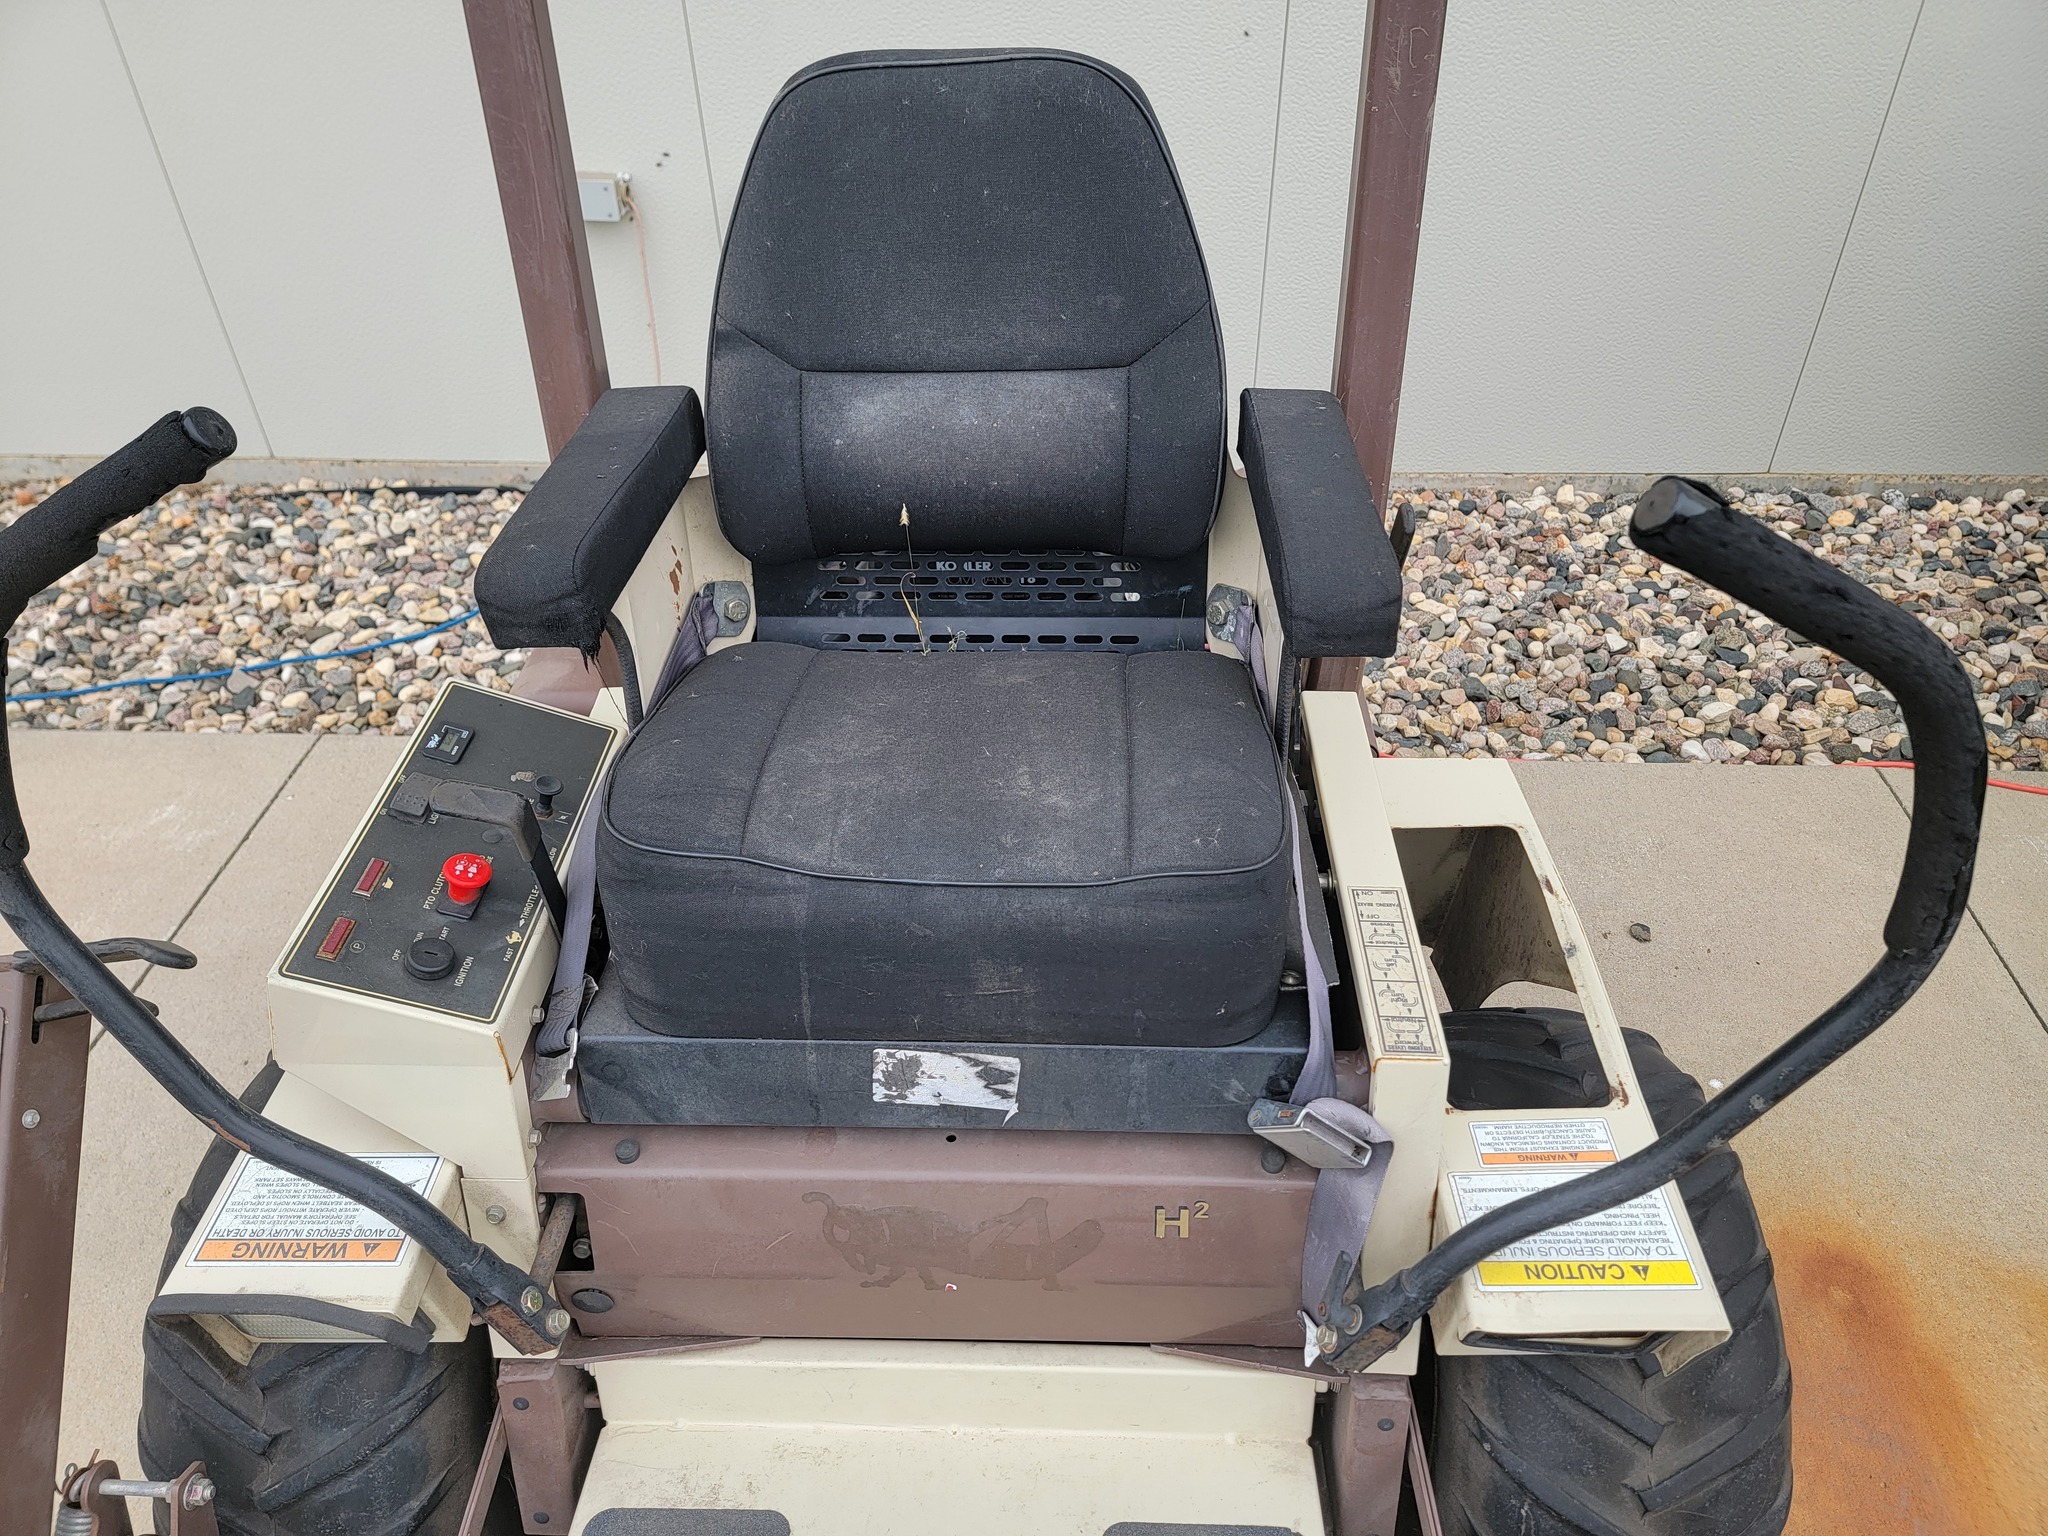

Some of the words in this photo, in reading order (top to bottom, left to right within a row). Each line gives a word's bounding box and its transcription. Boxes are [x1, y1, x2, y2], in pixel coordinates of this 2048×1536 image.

[936, 561, 992, 571] KOLER
[549, 846, 557, 862] LOW
[423, 895, 436, 910] PTO
[520, 888, 540, 919] THROTTLE
[391, 948, 402, 961] OFF
[503, 947, 514, 962] FAST
[453, 955, 475, 987] IGNITION
[1518, 1154, 1568, 1162] WARNING
[212, 1228, 248, 1237] DEATH
[248, 1228, 266, 1237] OR
[265, 1228, 304, 1237] INJURY
[305, 1228, 352, 1237] SERIOUS
[354, 1228, 386, 1237] AVOID
[388, 1228, 400, 1237] TO
[232, 1242, 348, 1258] WARNING
[1537, 1246, 1604, 1256] SERIOUS
[1608, 1246, 1651, 1256] AVOID
[1655, 1246, 1677, 1256] TO
[1523, 1264, 1625, 1280] CAUTION
